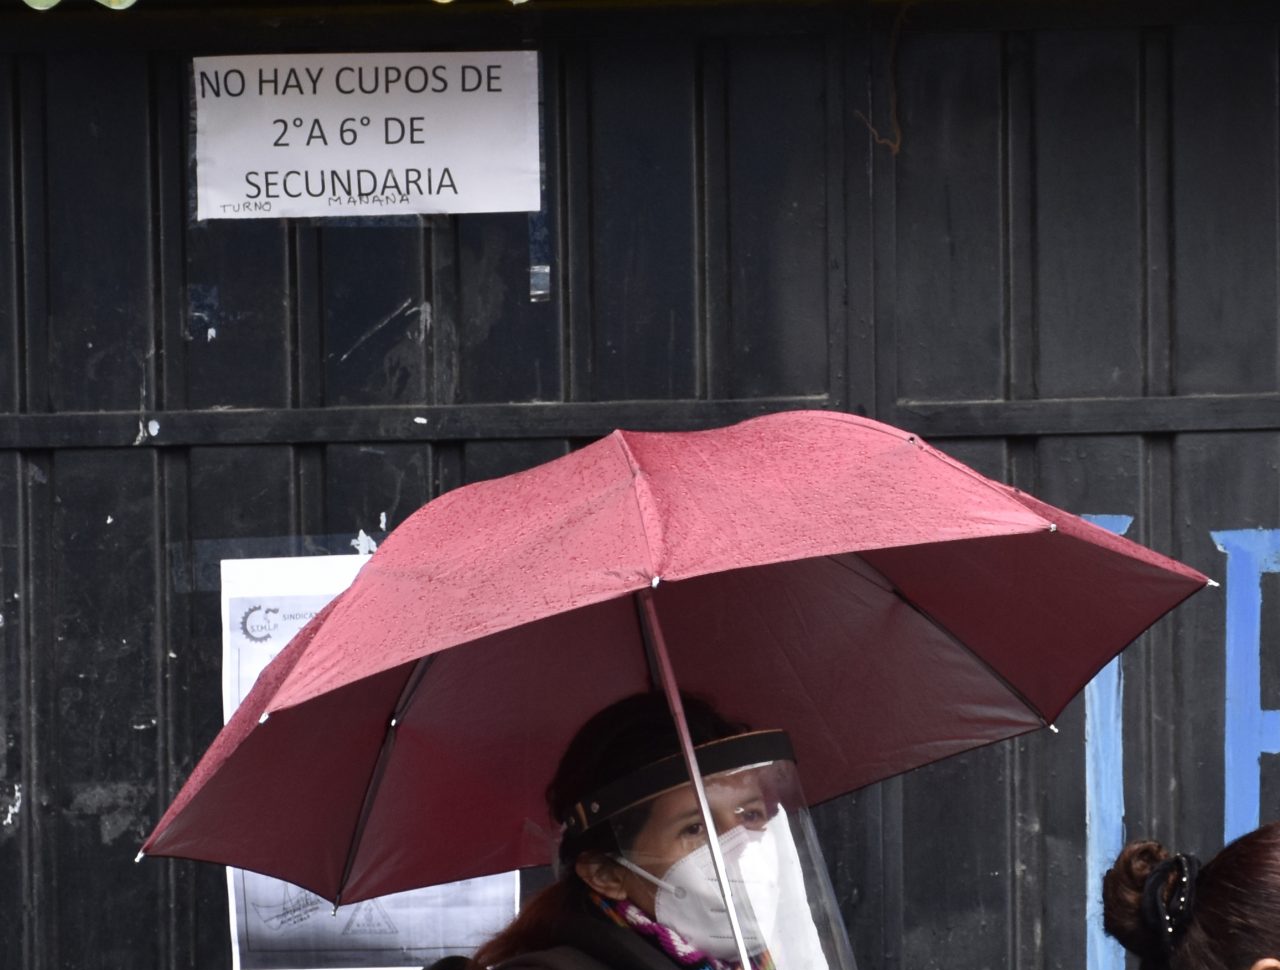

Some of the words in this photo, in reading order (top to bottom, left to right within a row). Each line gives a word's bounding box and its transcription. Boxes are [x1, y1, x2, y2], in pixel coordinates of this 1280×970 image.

[200, 69, 246, 98] NO
[258, 67, 324, 96] HAY
[335, 65, 448, 94] CUPOS
[461, 65, 502, 93] DE
[339, 116, 371, 145] 6°
[385, 117, 425, 145] DE
[245, 168, 458, 199] SECUNDARIA
[220, 201, 272, 213] TURNO
